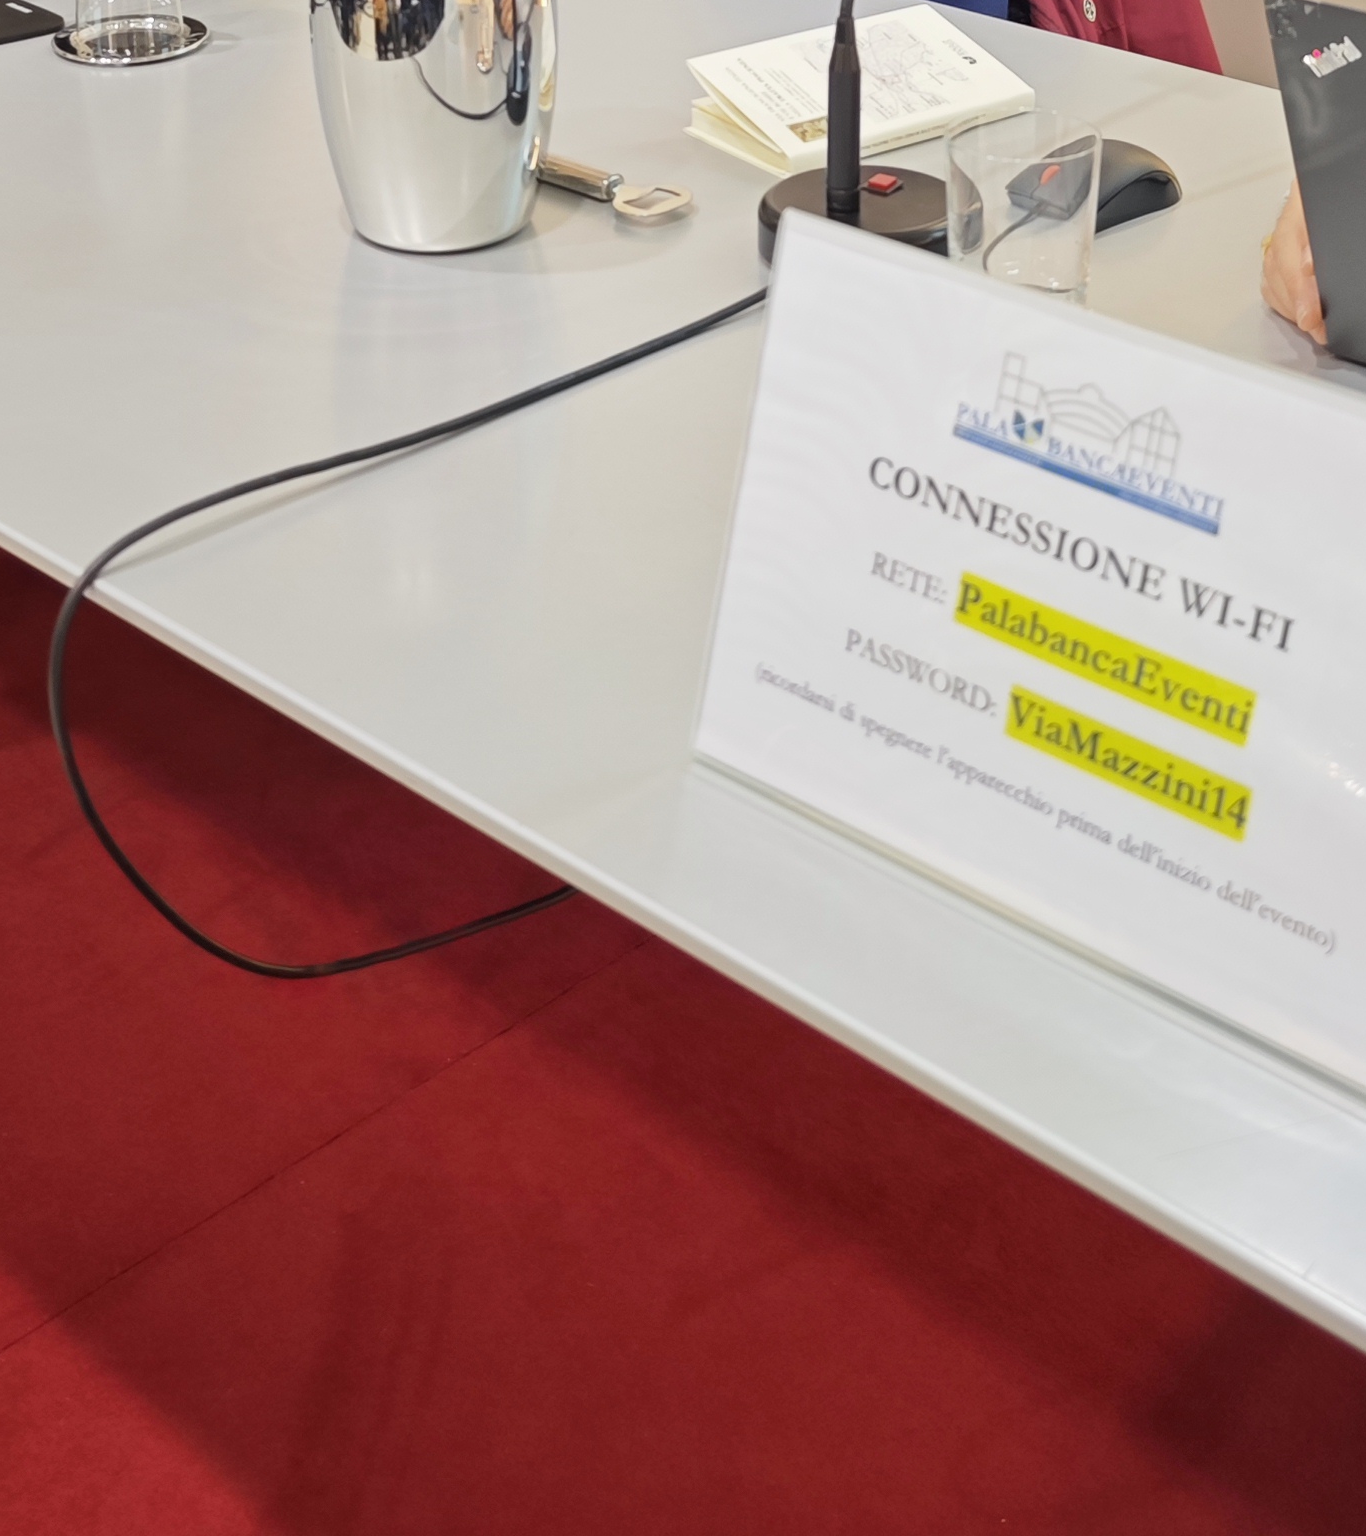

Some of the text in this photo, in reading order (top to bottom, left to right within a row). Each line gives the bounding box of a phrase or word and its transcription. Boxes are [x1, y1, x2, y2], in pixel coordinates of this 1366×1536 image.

[868, 455, 1295, 653] CONNESSIONE WI-FI
[870, 551, 1254, 736] RETE: PalabancaEventi
[844, 627, 1250, 831] PASSWORD: ViaMazzini14
[1055, 805, 1113, 846] prima
